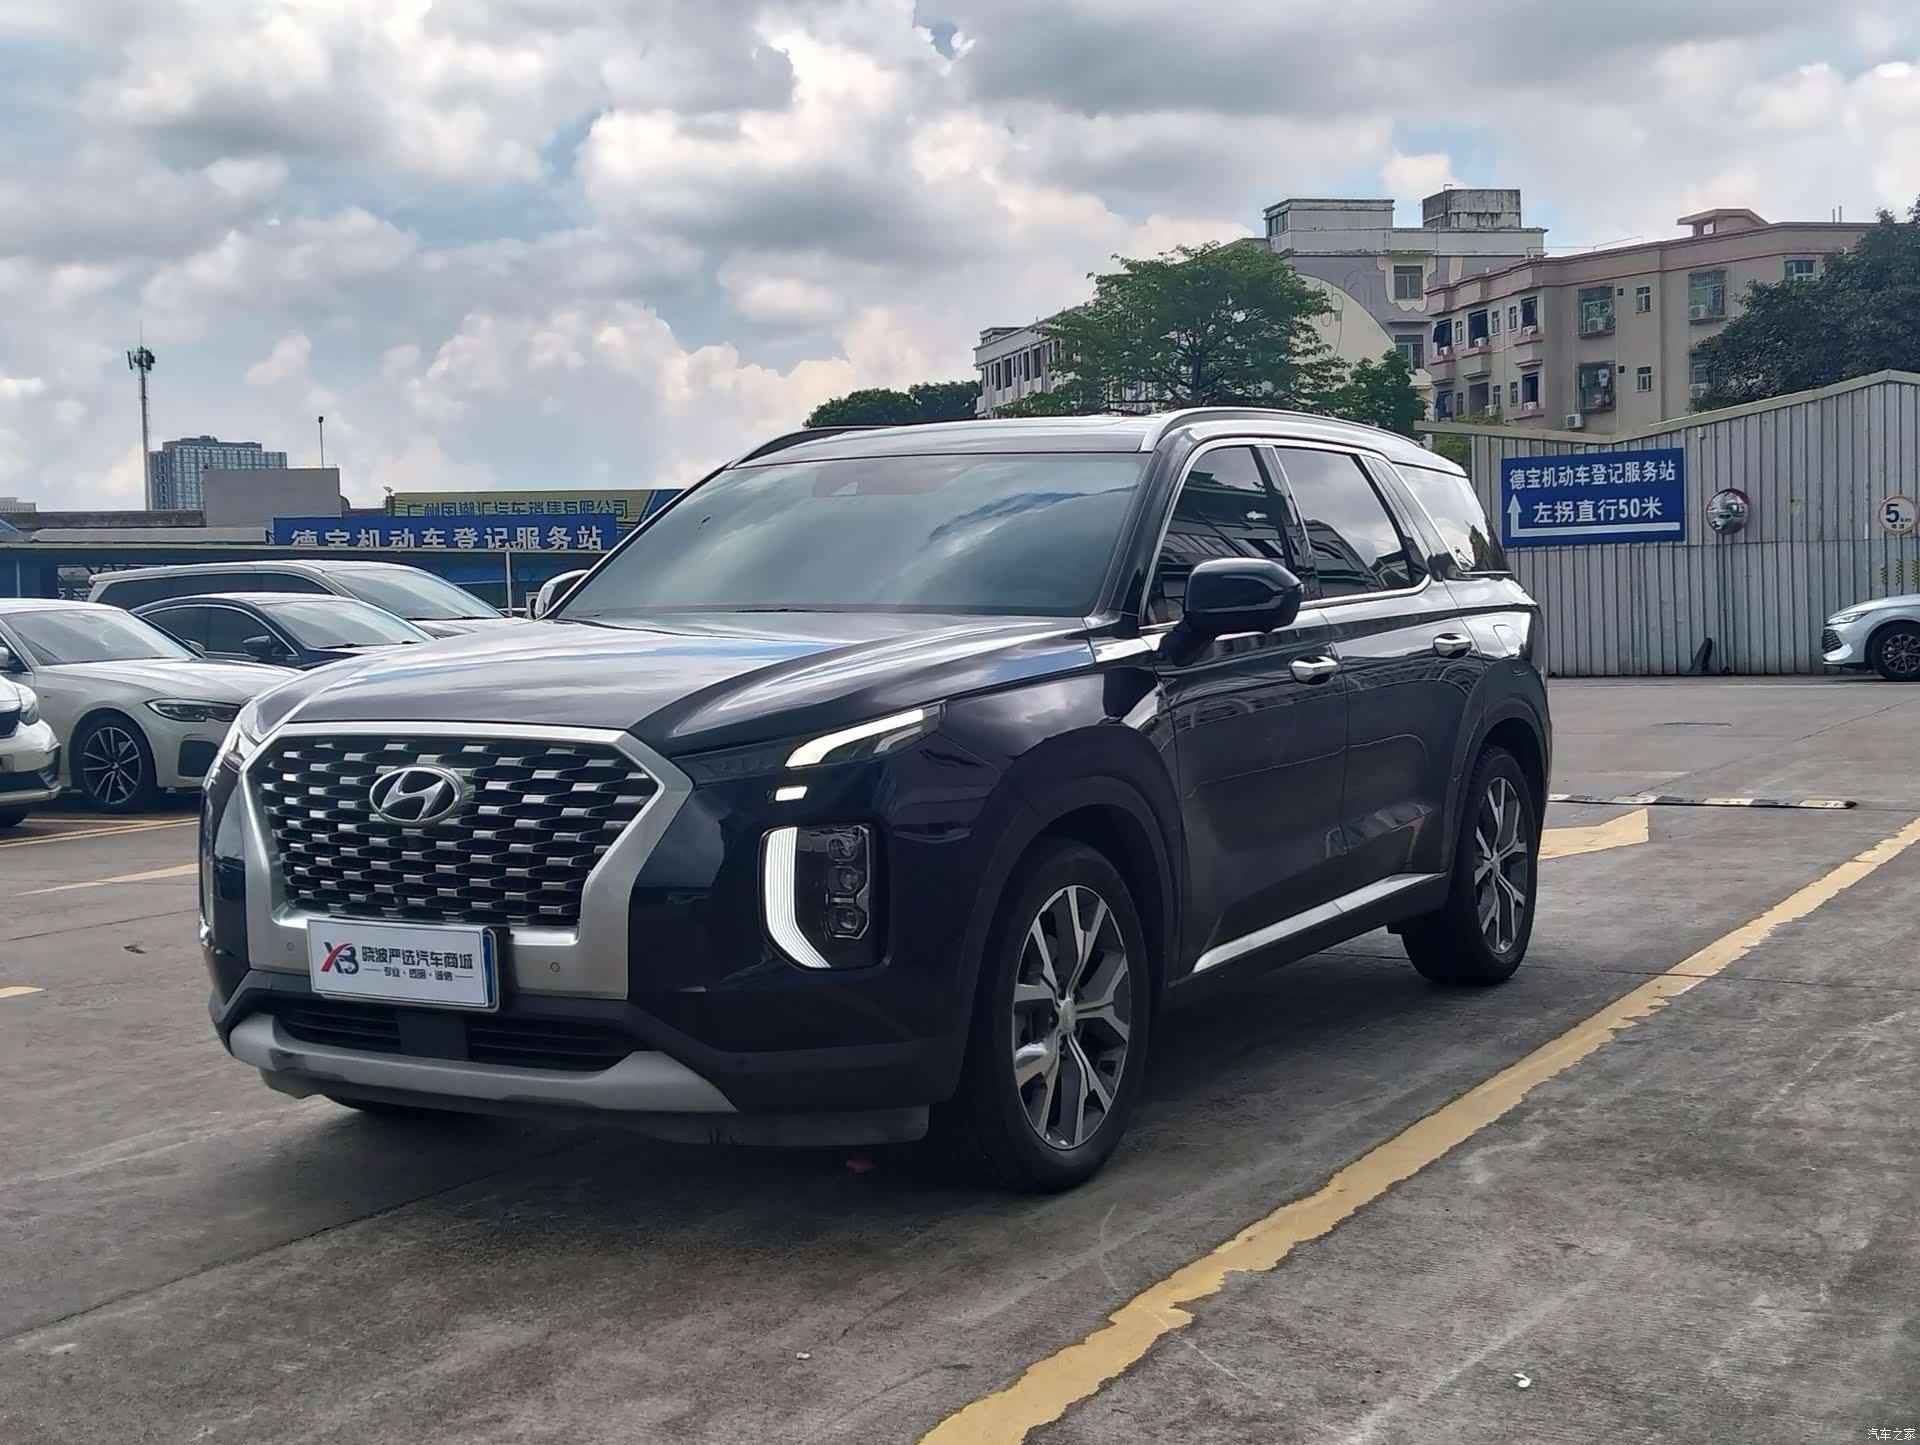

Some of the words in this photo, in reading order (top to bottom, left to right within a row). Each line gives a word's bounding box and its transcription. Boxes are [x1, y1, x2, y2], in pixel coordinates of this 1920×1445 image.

[1509, 459, 1676, 490] 德宝机动车登记服务站
[1532, 496, 1663, 524] 左拐直行50米
[1885, 503, 1900, 523] 5
[361, 945, 474, 970] 晓波严选汽车商城
